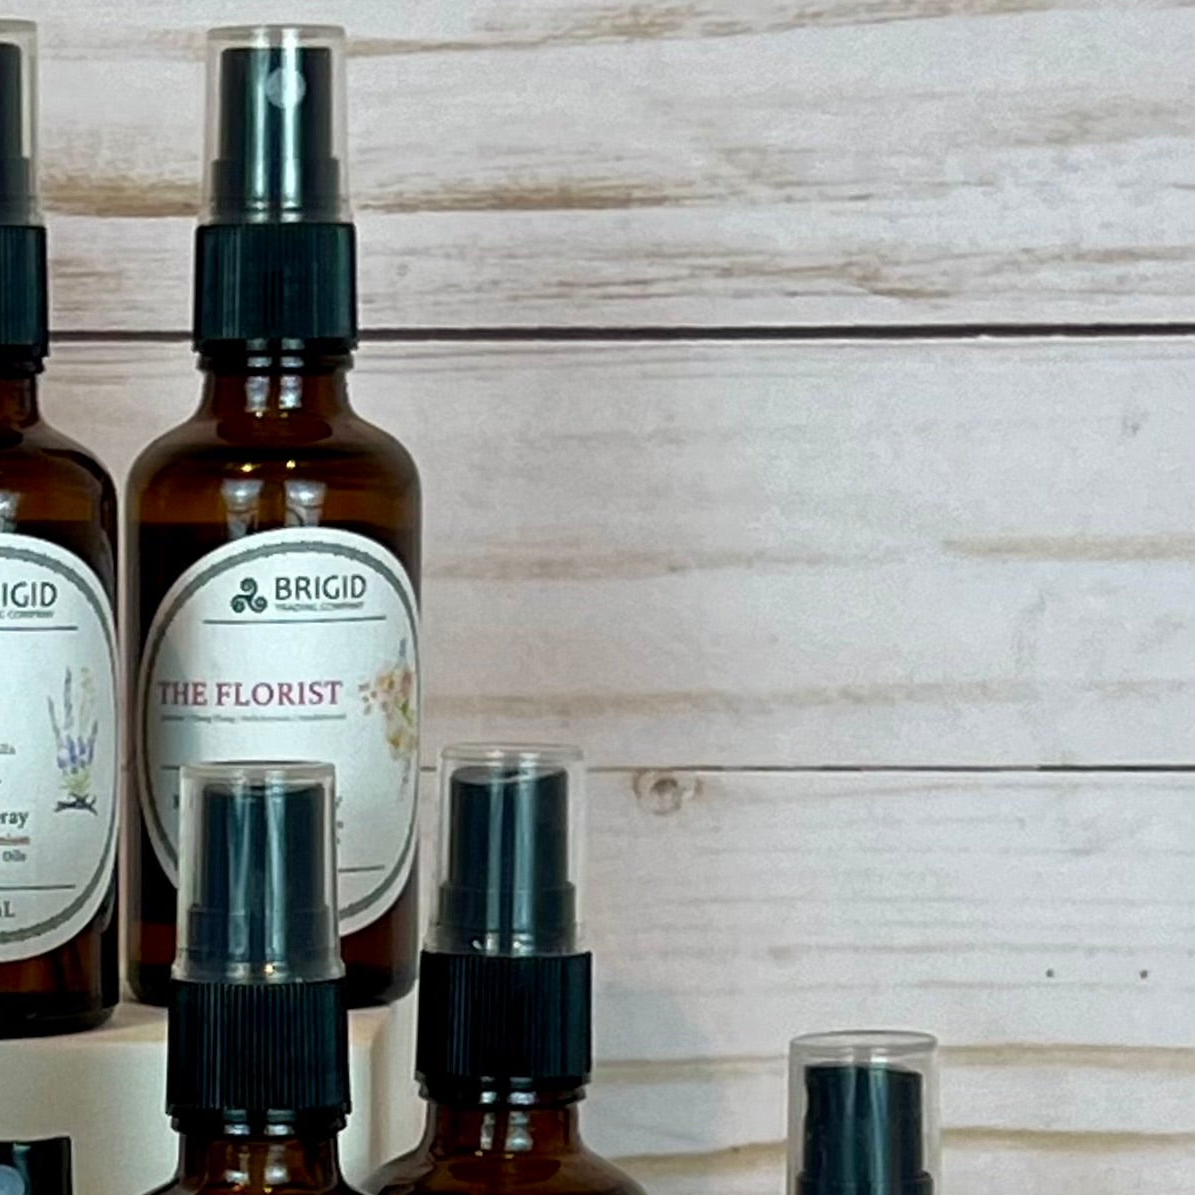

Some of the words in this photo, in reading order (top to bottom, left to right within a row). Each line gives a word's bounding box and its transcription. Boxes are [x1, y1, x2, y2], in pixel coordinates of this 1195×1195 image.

[275, 575, 366, 600] BRIGID
[158, 682, 207, 706] THE
[216, 681, 343, 706] FLORIST
[3, 850, 26, 863] Oils
